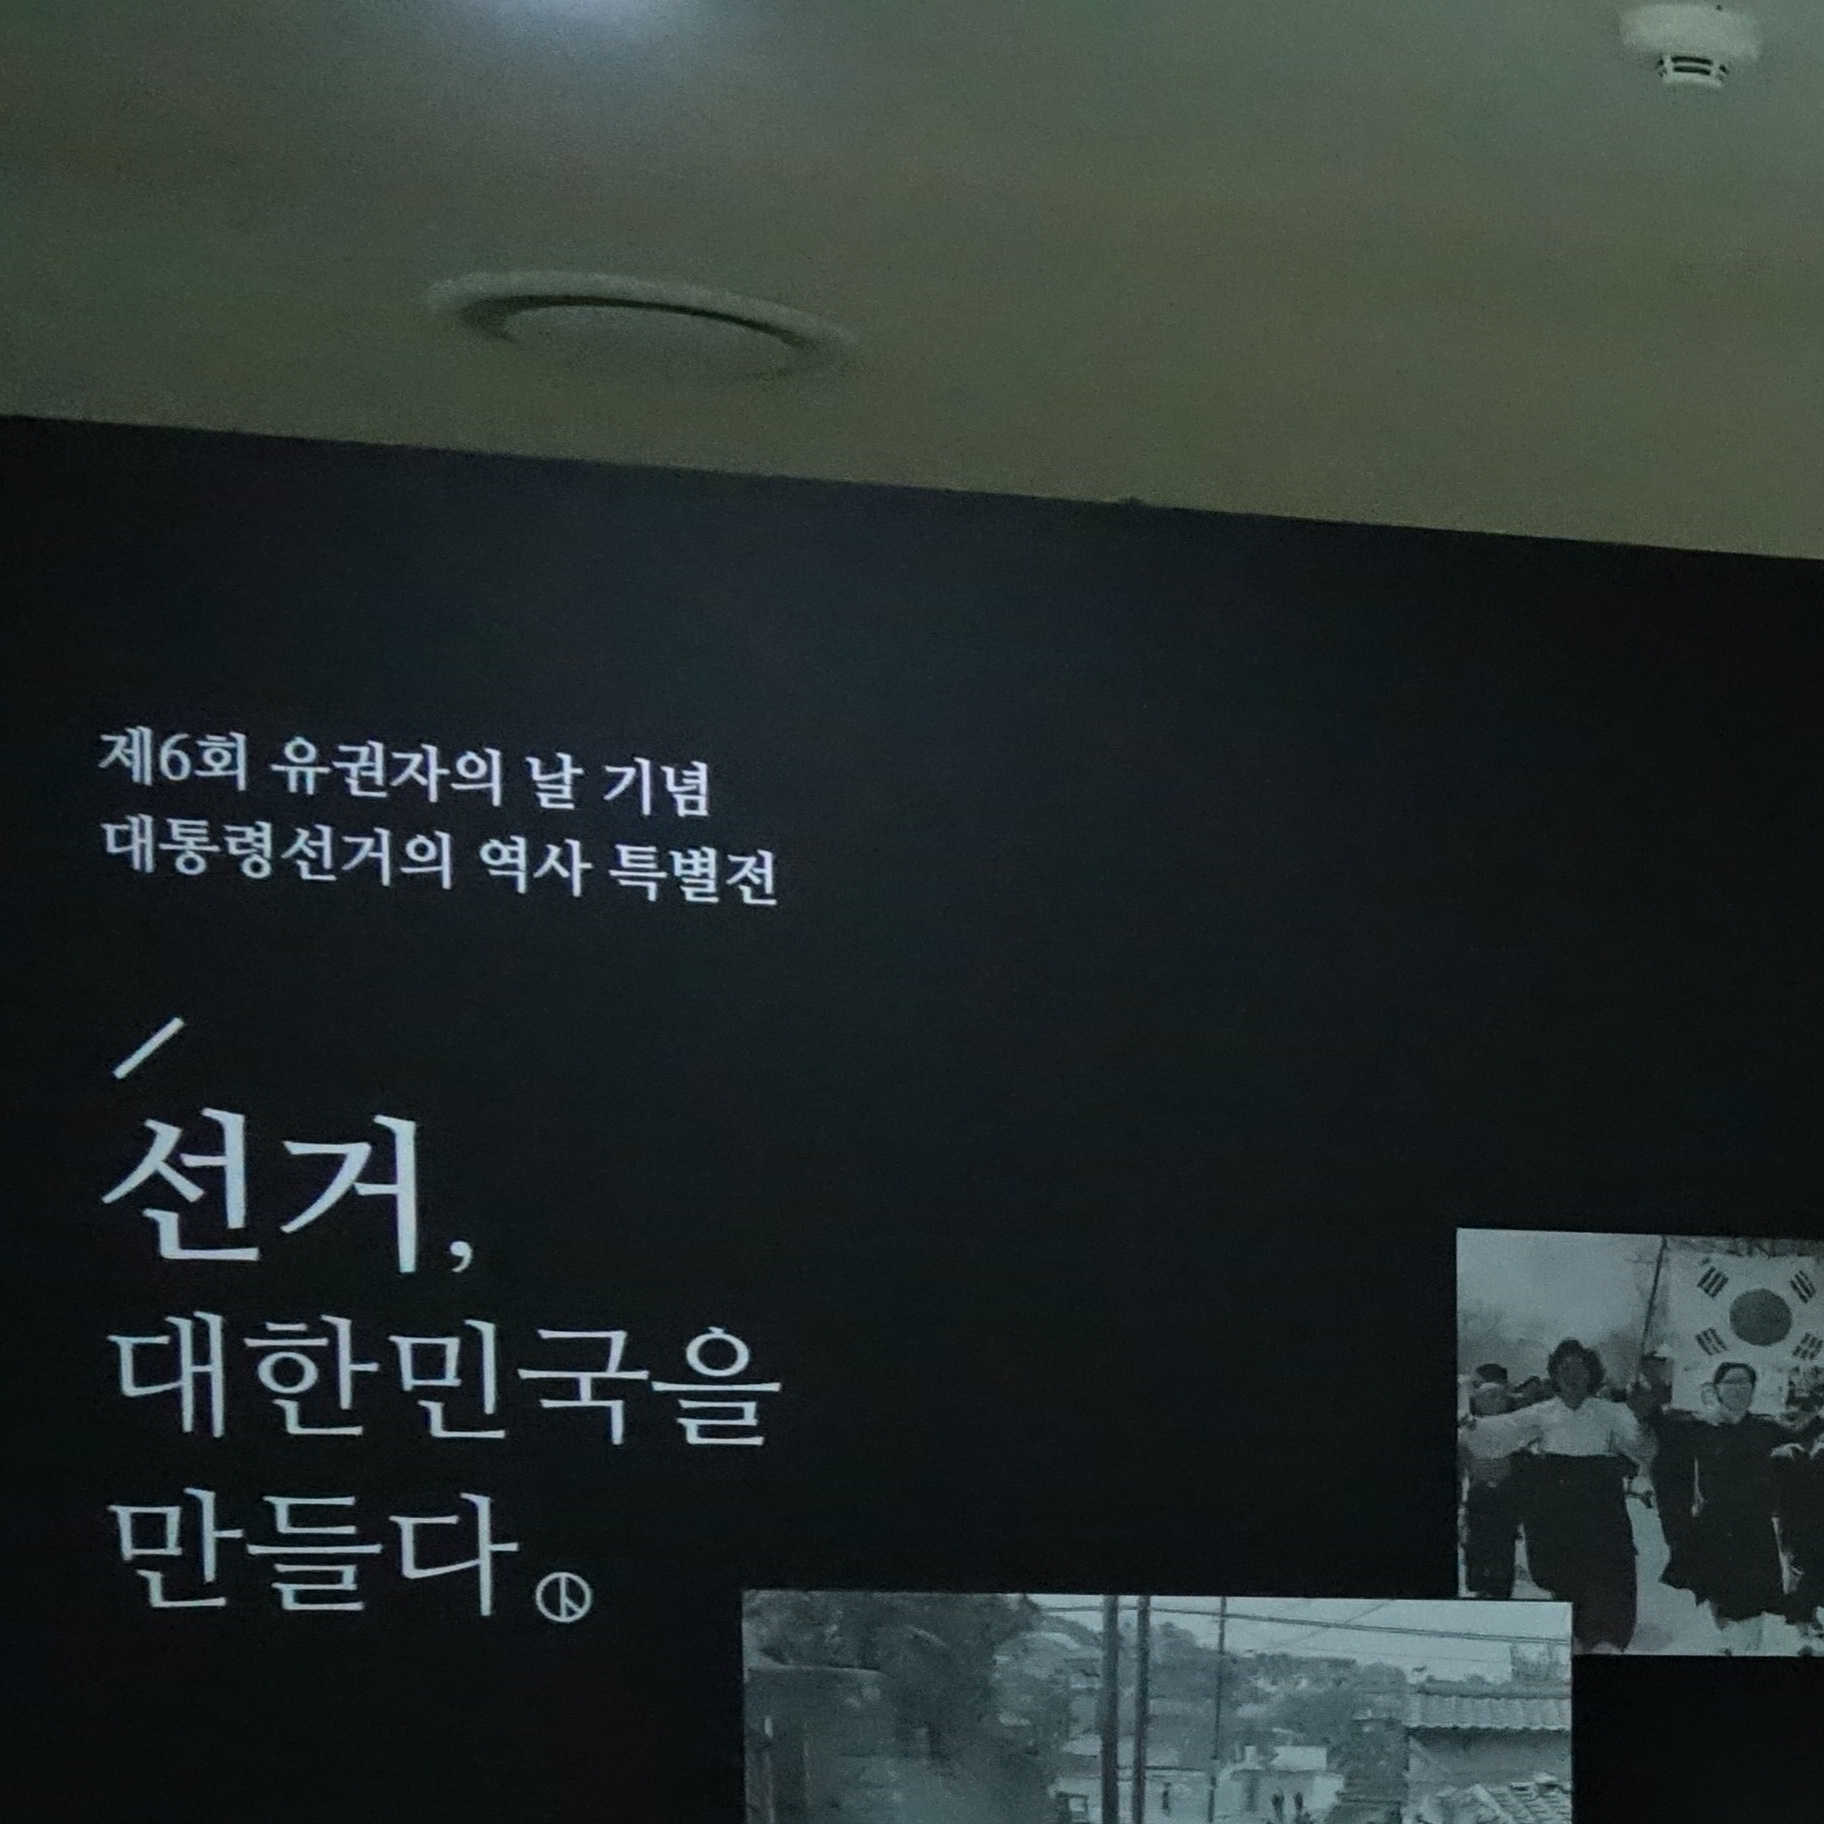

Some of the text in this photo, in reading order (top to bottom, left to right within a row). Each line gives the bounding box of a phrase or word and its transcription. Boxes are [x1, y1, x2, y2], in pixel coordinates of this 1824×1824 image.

[98, 725, 709, 818] 제6회 유권자의 날 기념
[101, 813, 778, 906] 대통령선거의 역사 특별전
[102, 1107, 473, 1274] 선거,
[107, 1310, 782, 1447] 대한민국을
